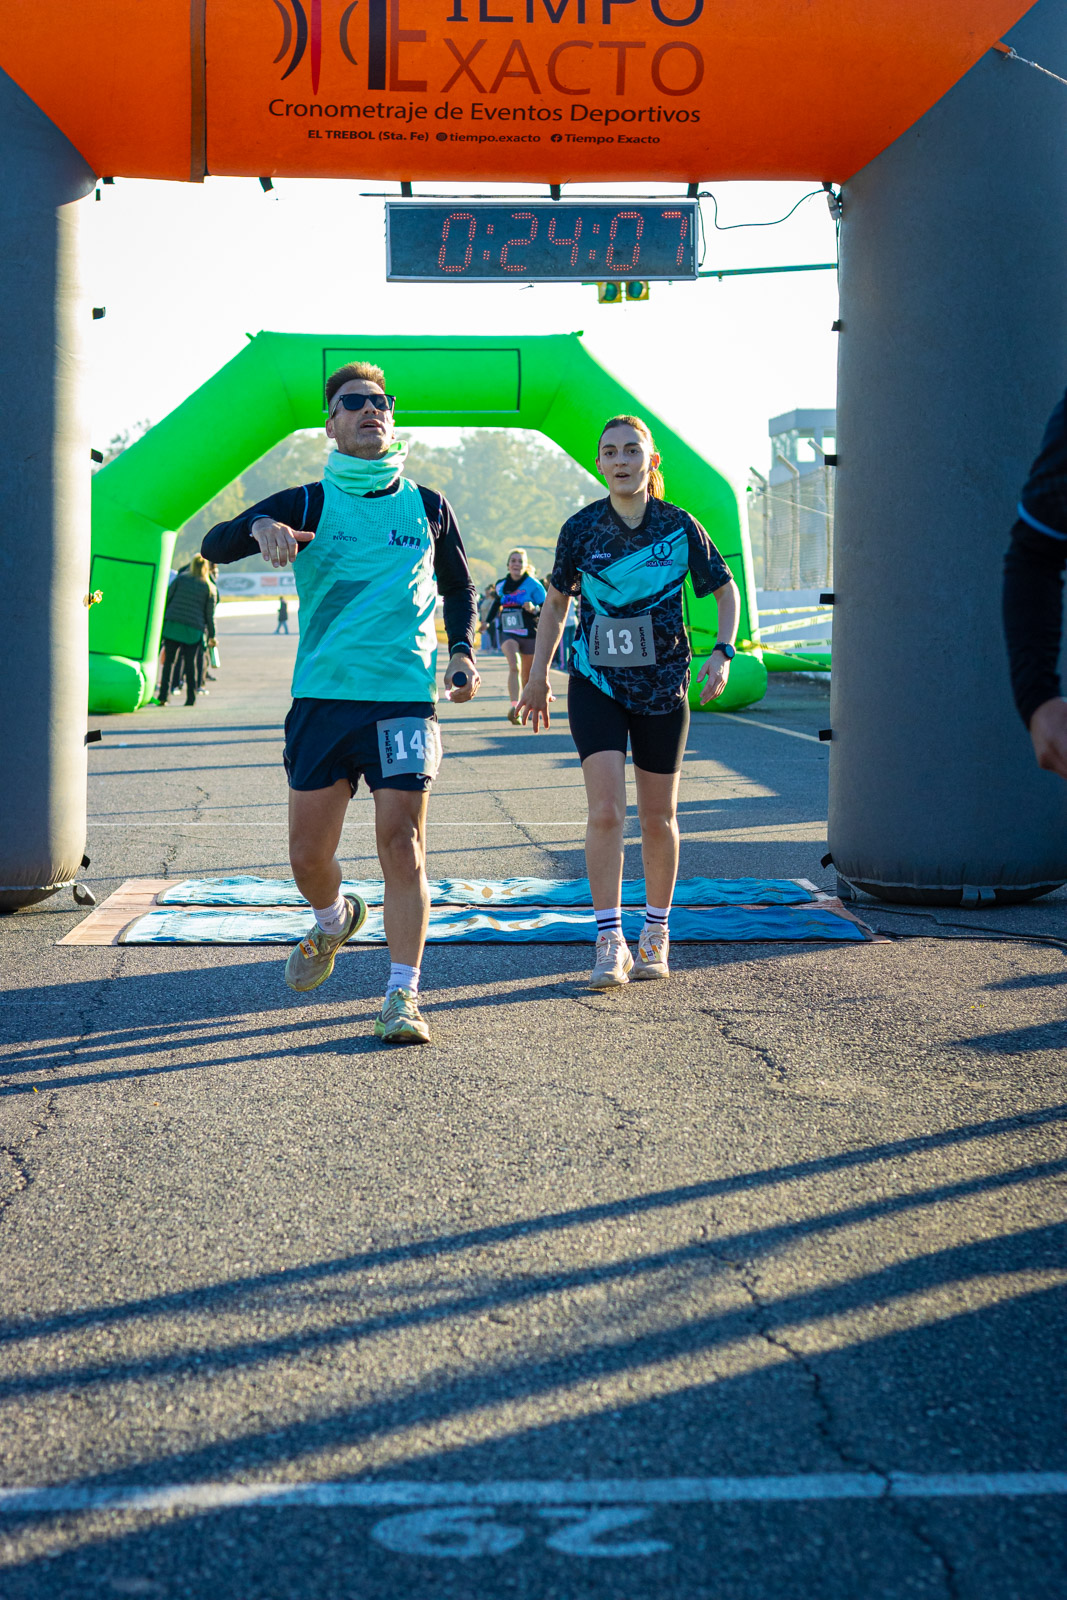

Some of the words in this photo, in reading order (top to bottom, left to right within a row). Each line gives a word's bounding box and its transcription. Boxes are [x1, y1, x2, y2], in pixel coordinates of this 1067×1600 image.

[389, 0, 705, 97] EXACTO
[269, 99, 427, 123] Cronometraje
[434, 102, 463, 120] de
[471, 103, 562, 121] Eventos
[571, 104, 700, 126] Deportivos
[308, 130, 323, 139] EL
[325, 131, 375, 140] TREBOL
[379, 131, 407, 141] (Sta.
[410, 132, 429, 142] Fe)
[450, 132, 541, 144] tiempo.exacto
[565, 134, 614, 144] Tiempo
[617, 135, 660, 144] Exacto
[438, 212, 688, 272] 0:24:07
[606, 629, 634, 655] 13
[383, 729, 393, 764] TIEMPO
